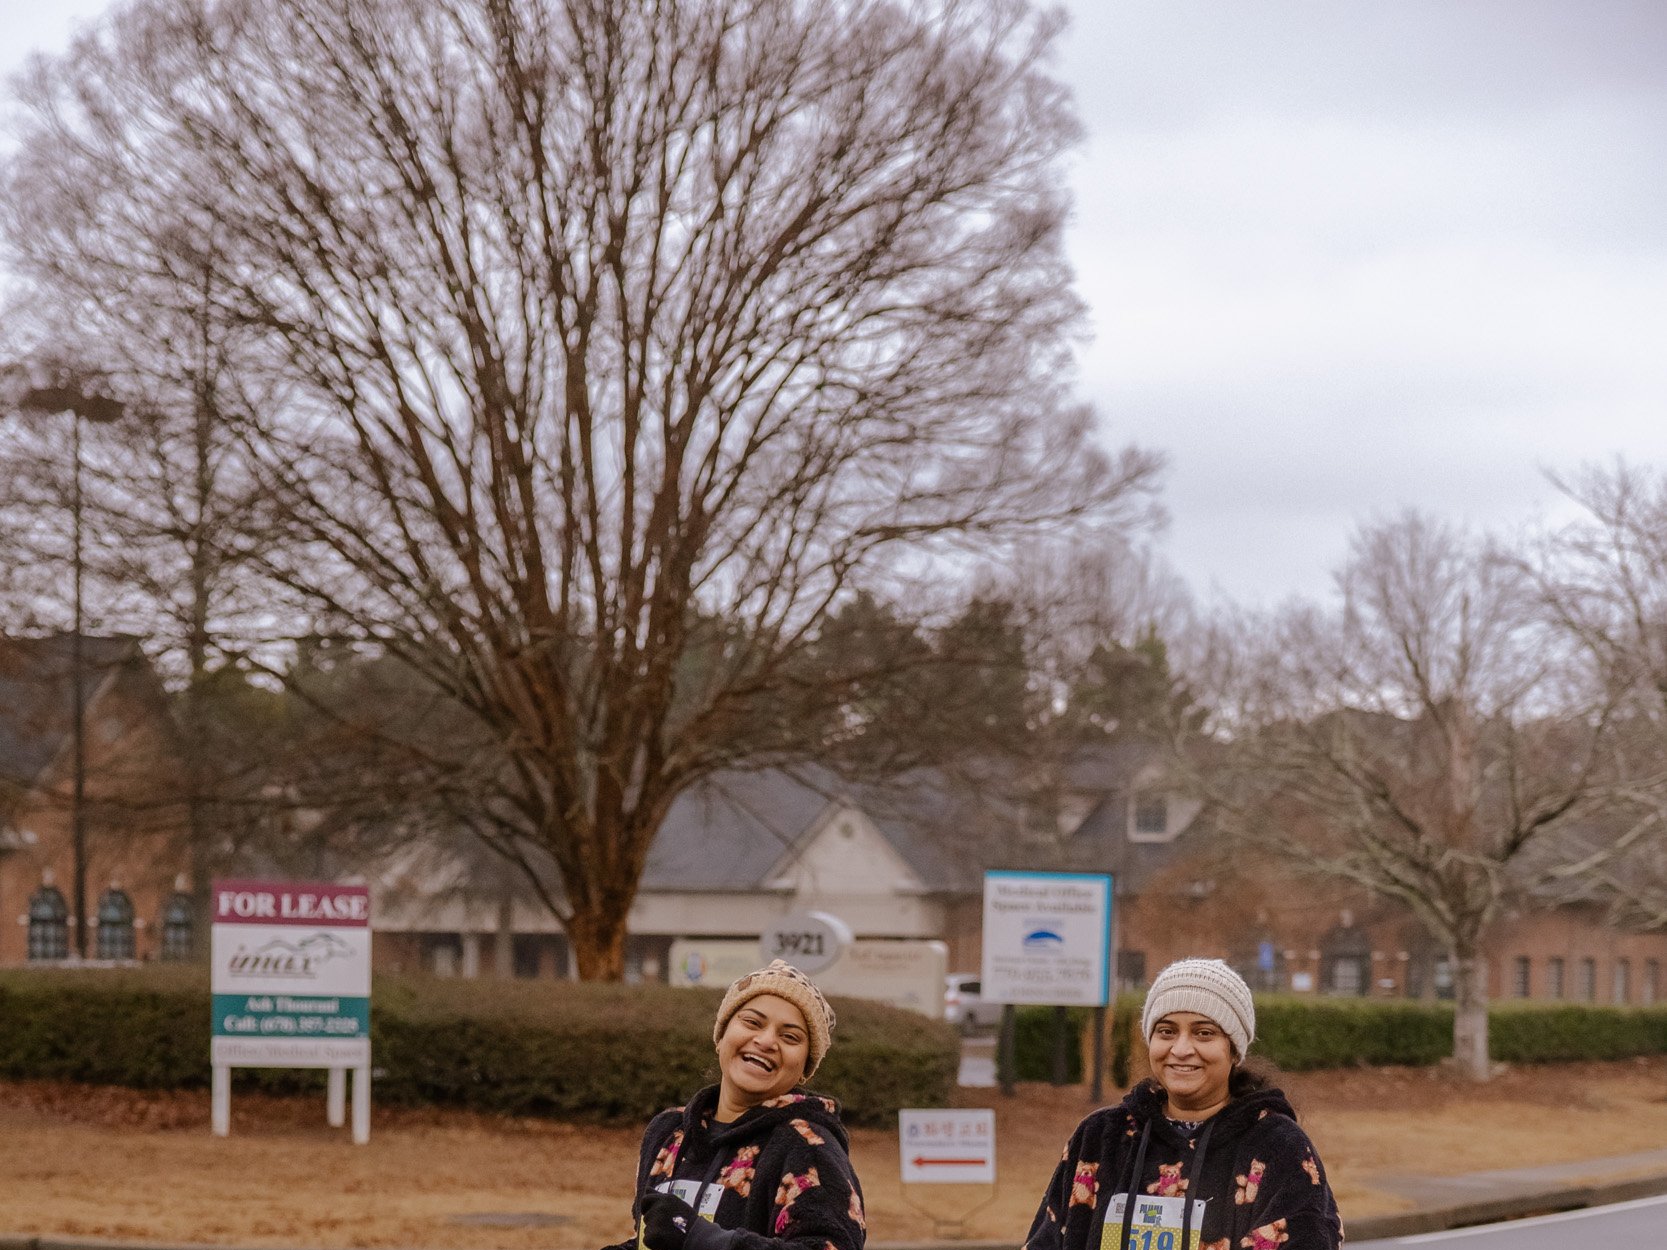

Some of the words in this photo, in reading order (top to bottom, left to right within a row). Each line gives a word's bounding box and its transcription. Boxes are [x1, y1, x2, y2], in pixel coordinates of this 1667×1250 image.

[218, 891, 277, 918] FOR
[280, 893, 368, 921] LEASE
[775, 931, 825, 956] 3921
